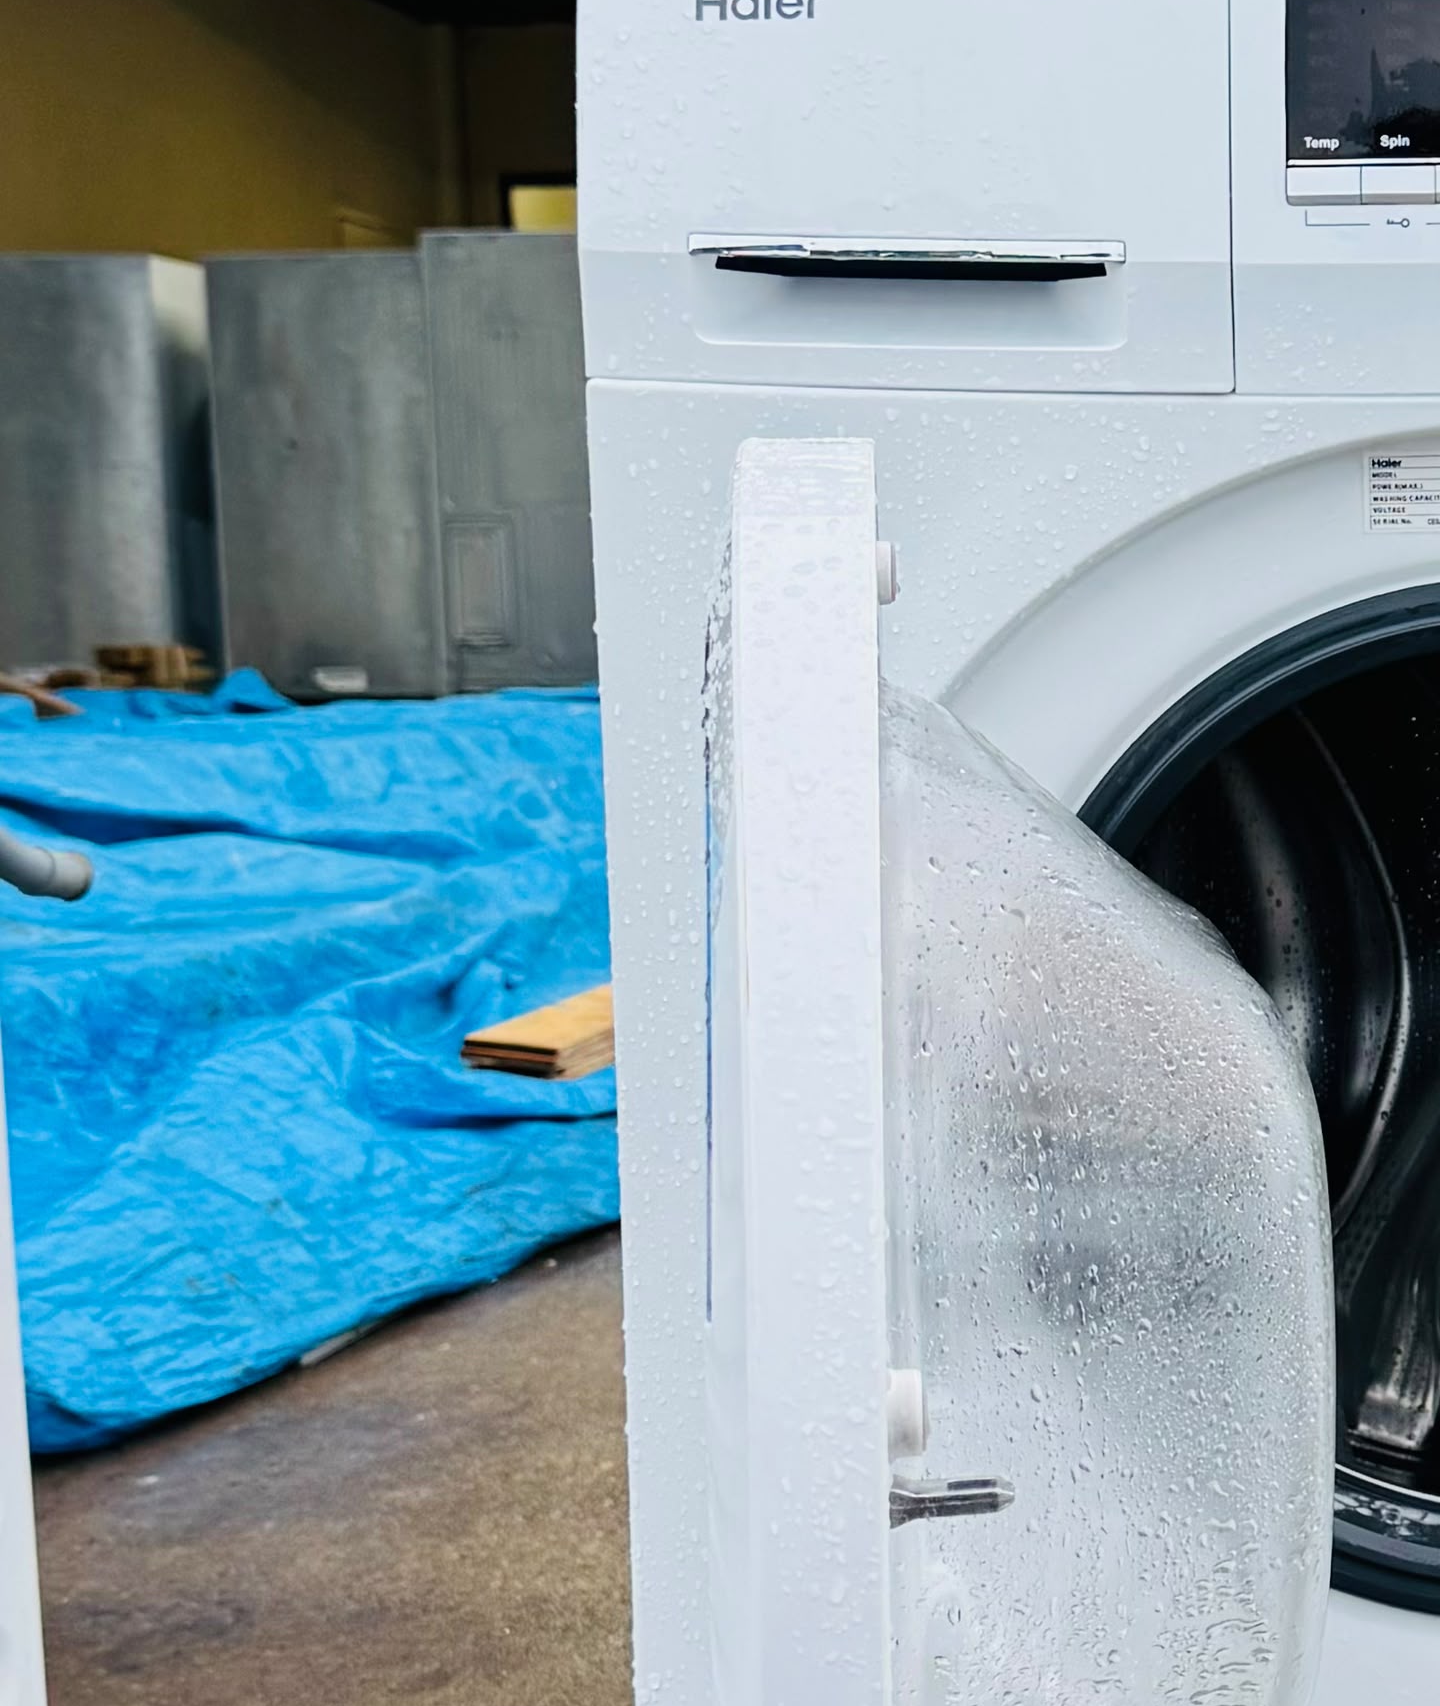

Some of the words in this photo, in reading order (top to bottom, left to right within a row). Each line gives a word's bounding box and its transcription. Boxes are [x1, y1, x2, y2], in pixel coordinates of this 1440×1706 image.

[1304, 135, 1340, 151] Temp
[1379, 133, 1410, 149] Spin
[1371, 459, 1402, 468] Haier
